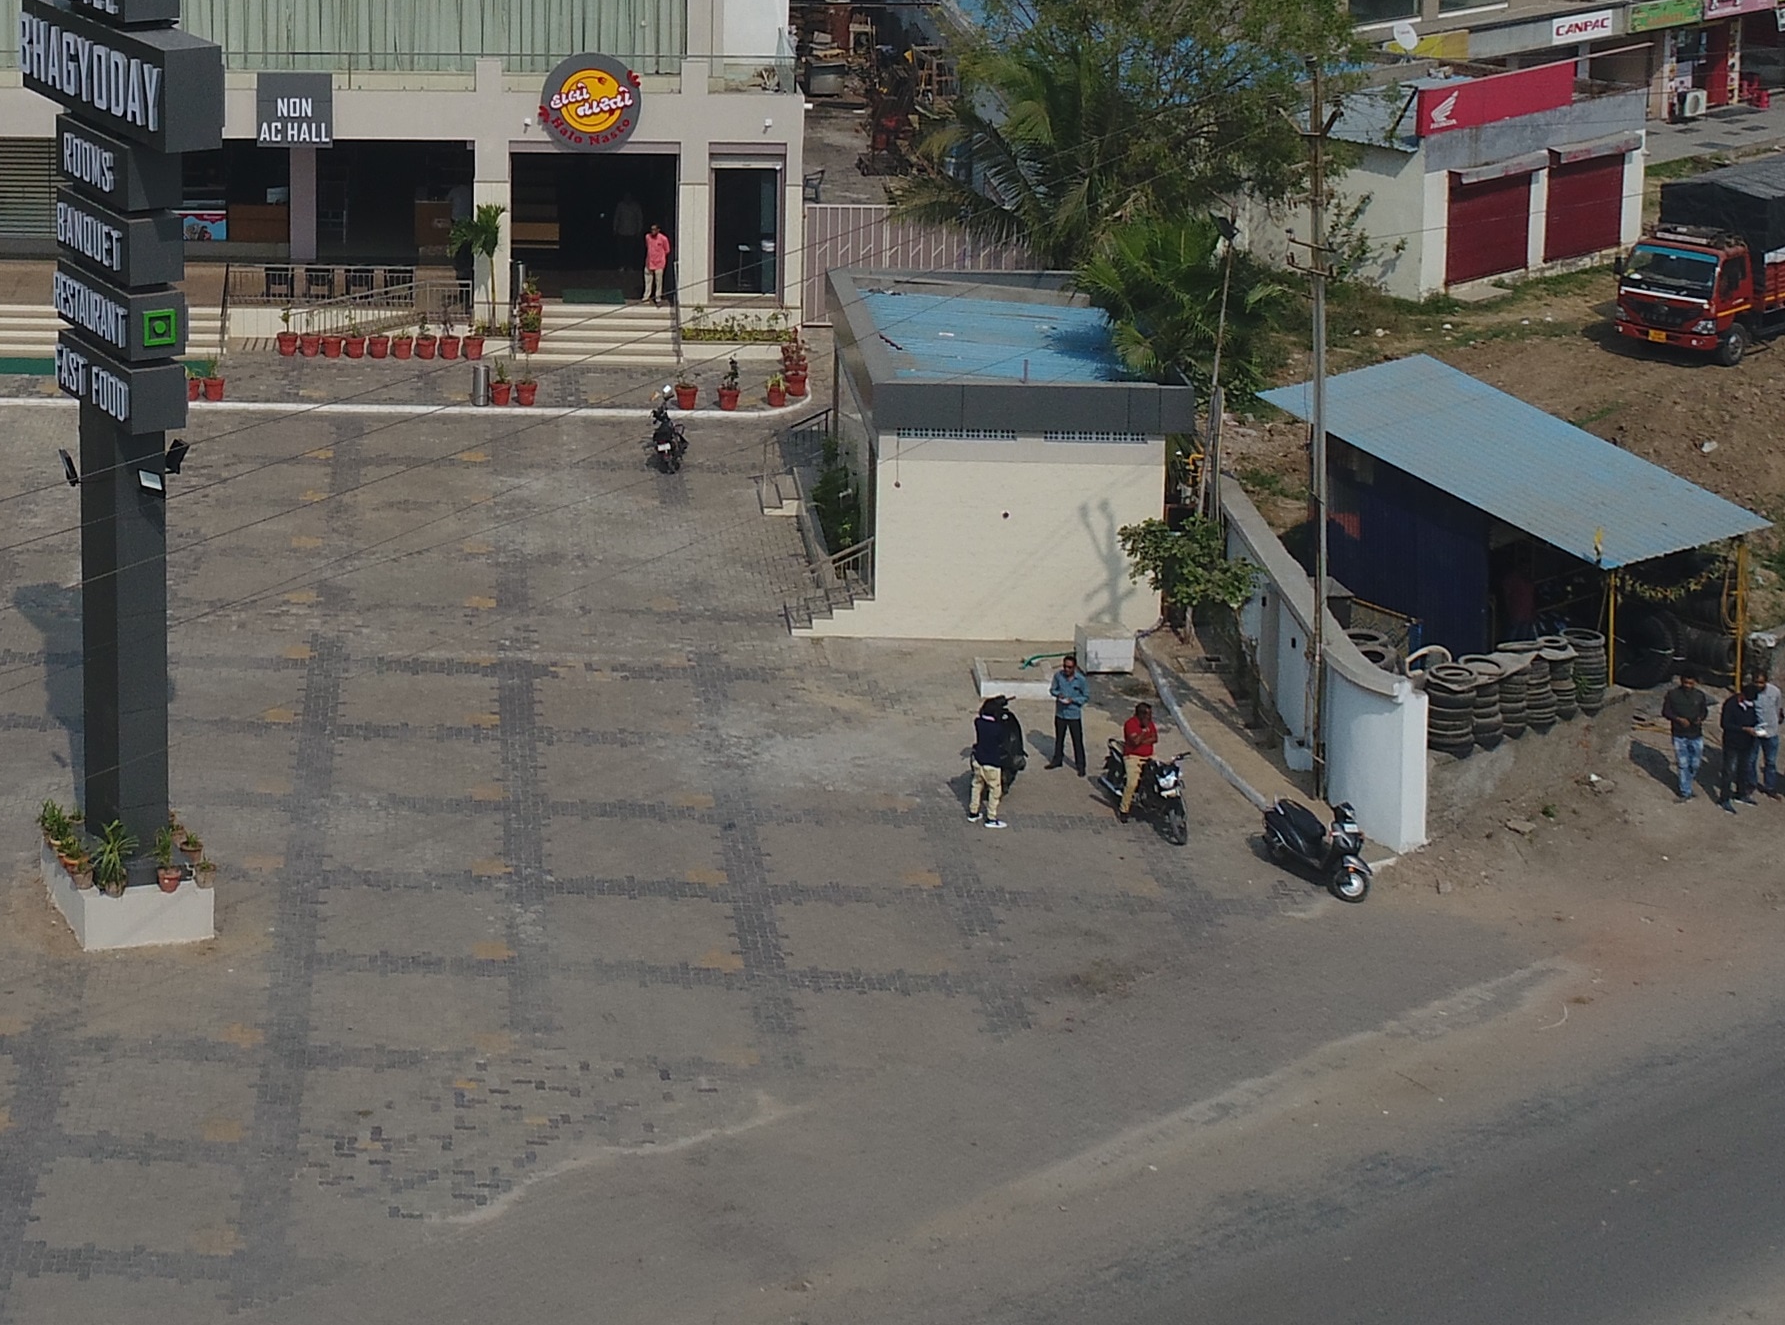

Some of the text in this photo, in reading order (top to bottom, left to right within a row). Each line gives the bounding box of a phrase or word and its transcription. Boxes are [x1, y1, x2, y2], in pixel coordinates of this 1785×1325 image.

[1556, 17, 1610, 36] CANPAC
[19, 12, 163, 132] BHAGYODAY
[259, 122, 330, 142] AC HALL
[277, 98, 312, 117] NON
[63, 132, 114, 192] ROOMS
[57, 202, 122, 271] BANQUET
[53, 271, 128, 348] RESTAURANT
[55, 343, 129, 422] FAST FOOD
